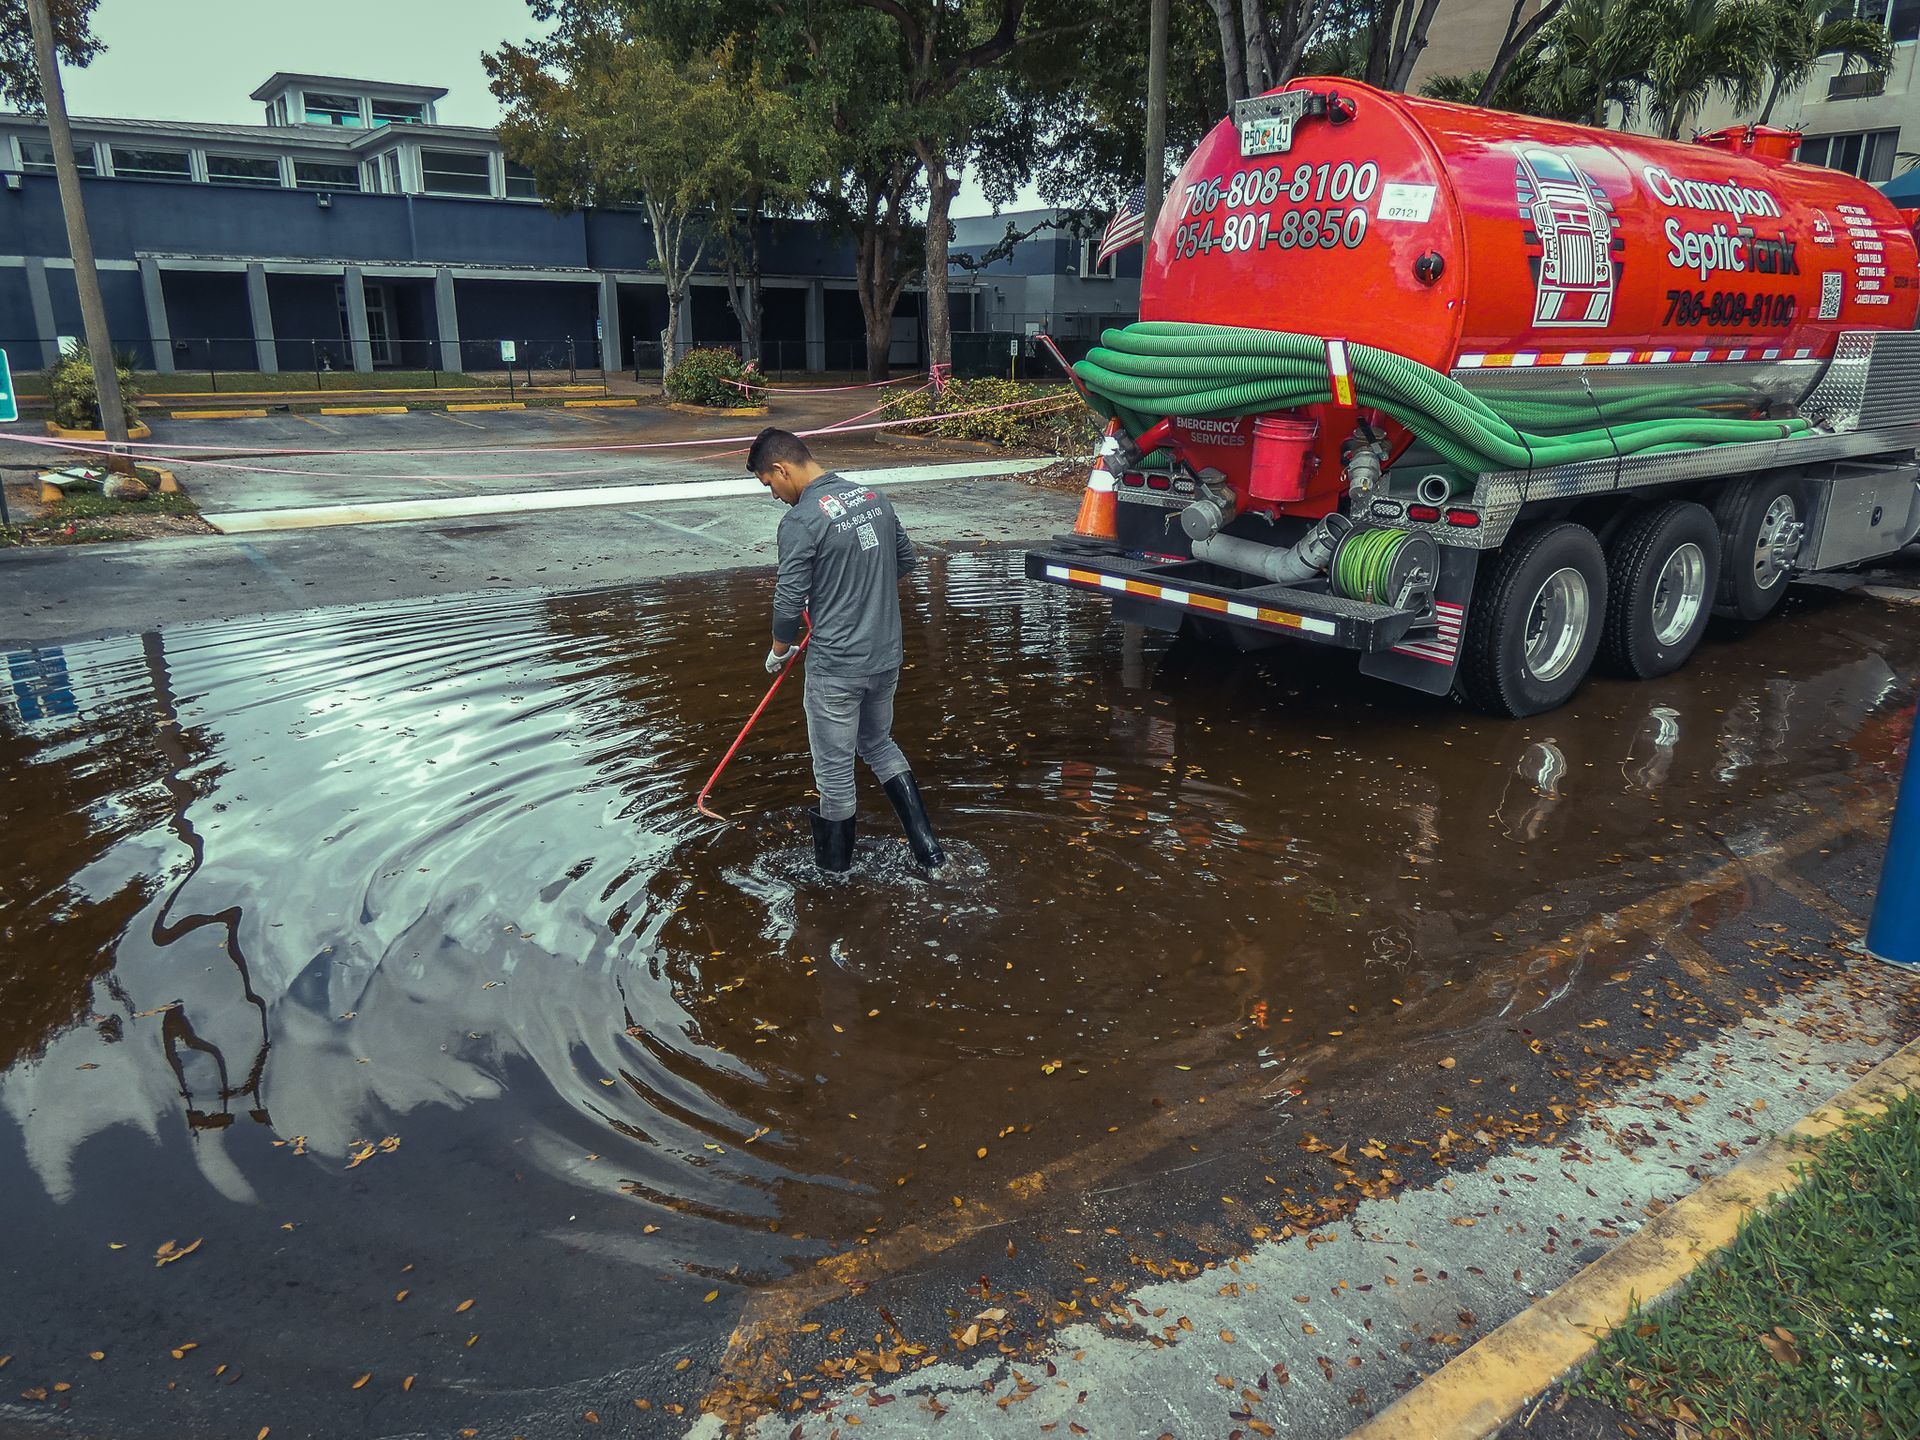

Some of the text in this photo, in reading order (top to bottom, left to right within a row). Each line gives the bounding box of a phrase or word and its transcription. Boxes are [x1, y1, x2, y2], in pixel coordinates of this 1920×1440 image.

[1180, 161, 1379, 219] 786-808-8100
[1643, 166, 1781, 223] Champion
[1389, 207, 1418, 218] 07121
[1175, 207, 1368, 258] 954-801-8850
[1663, 291, 1795, 327] 786-808-8100
[1176, 417, 1239, 433] EMERGENCY
[1191, 432, 1245, 446] SERVICES
